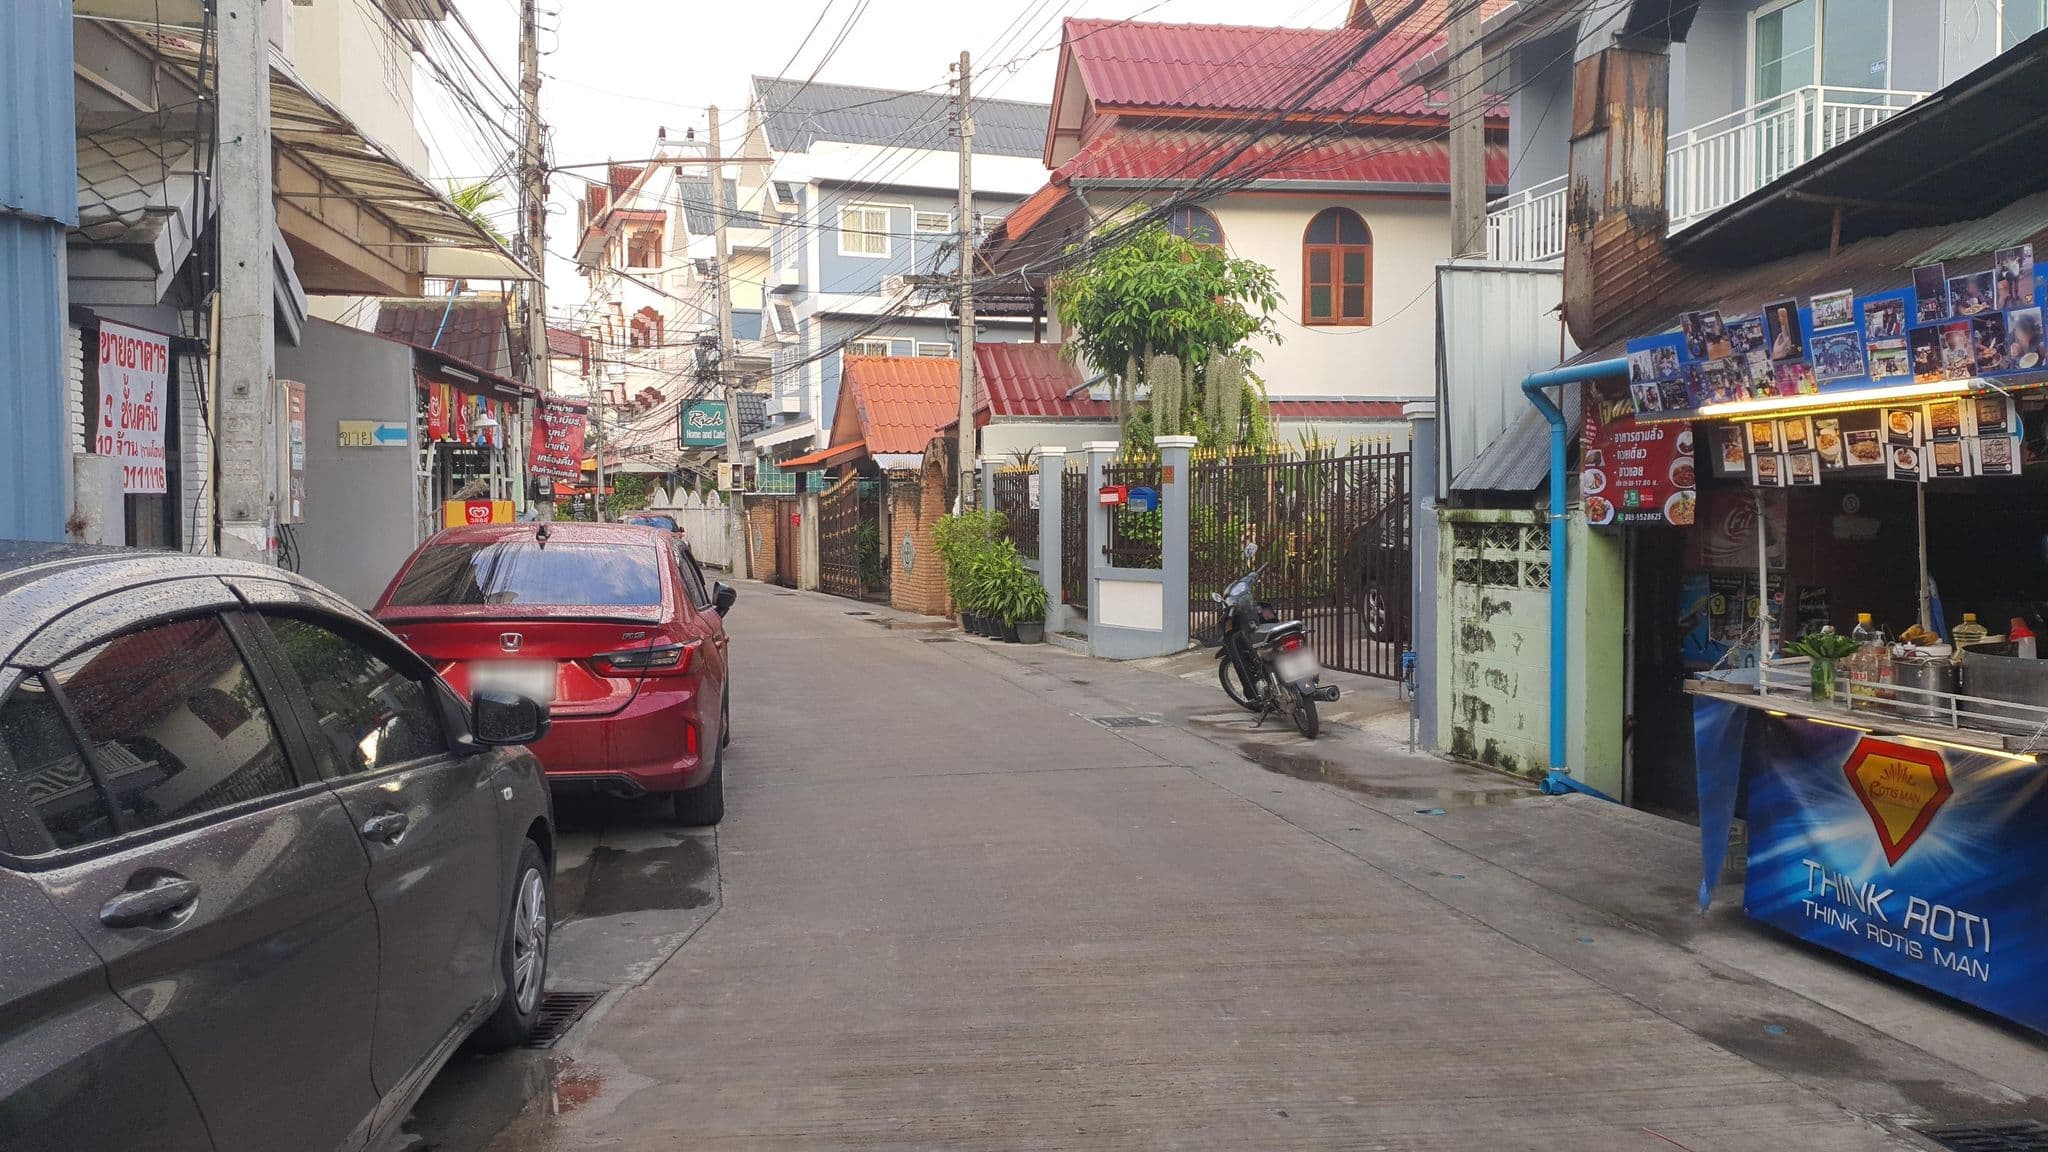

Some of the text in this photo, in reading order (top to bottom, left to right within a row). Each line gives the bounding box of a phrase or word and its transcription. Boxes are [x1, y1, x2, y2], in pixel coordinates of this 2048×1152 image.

[104, 394, 113, 428] 3
[689, 410, 724, 429] Rich
[340, 432, 372, 446] ขาย
[686, 430, 701, 439] Home
[702, 430, 712, 439] and
[1614, 425, 1664, 443] อาหารตามสั่ง
[97, 436, 112, 455] 10
[1802, 858, 1990, 953] THINK ROTI
[1802, 899, 1990, 982] THINK ROTIS MAN
